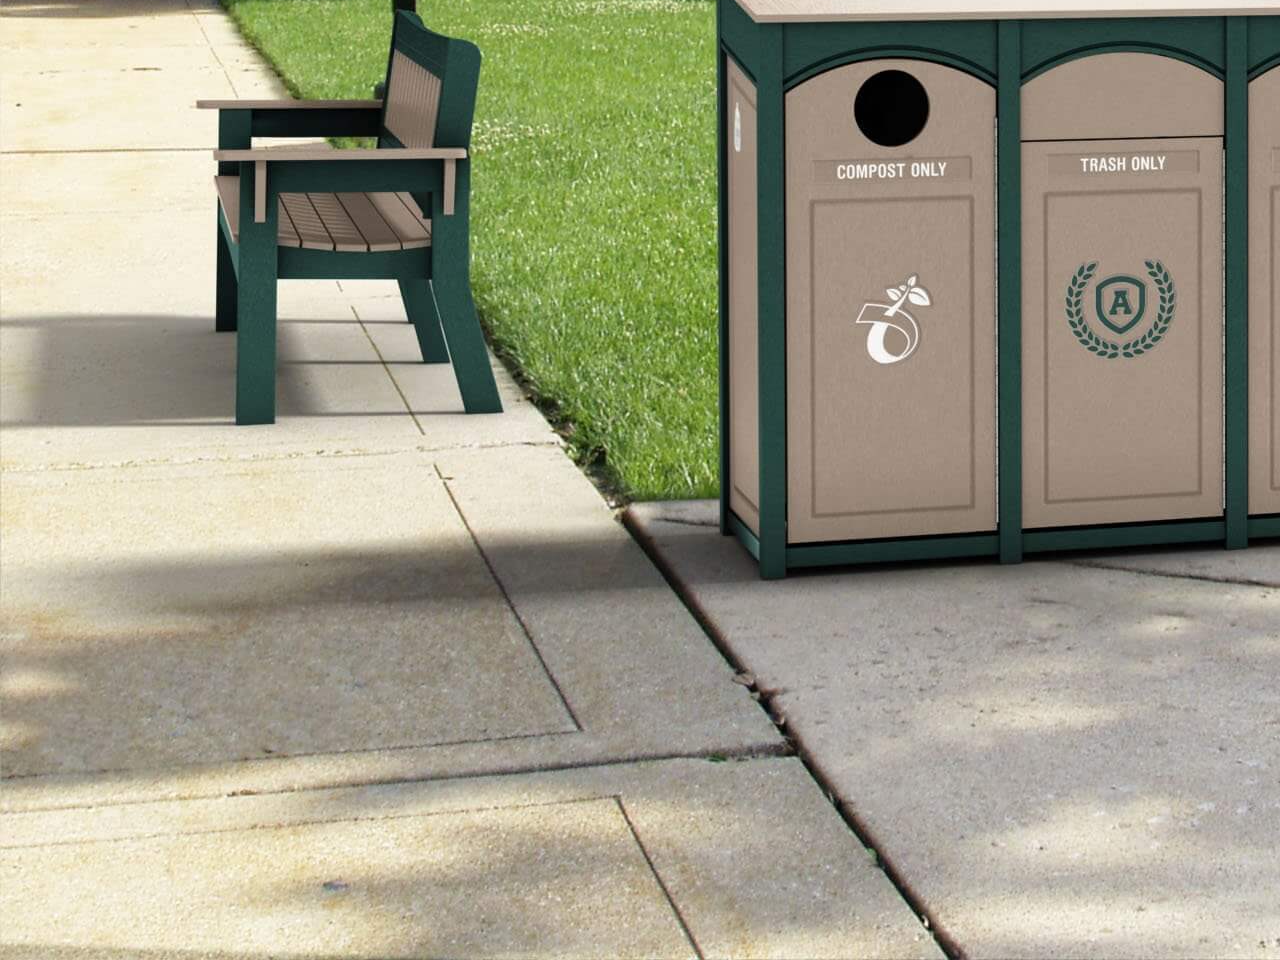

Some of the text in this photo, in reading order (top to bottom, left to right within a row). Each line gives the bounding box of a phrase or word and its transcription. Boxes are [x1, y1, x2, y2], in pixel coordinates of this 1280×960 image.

[837, 162, 947, 180] COMPOST ONLY
[1080, 155, 1166, 172] TRASH ONLY
[1110, 290, 1132, 316] A
